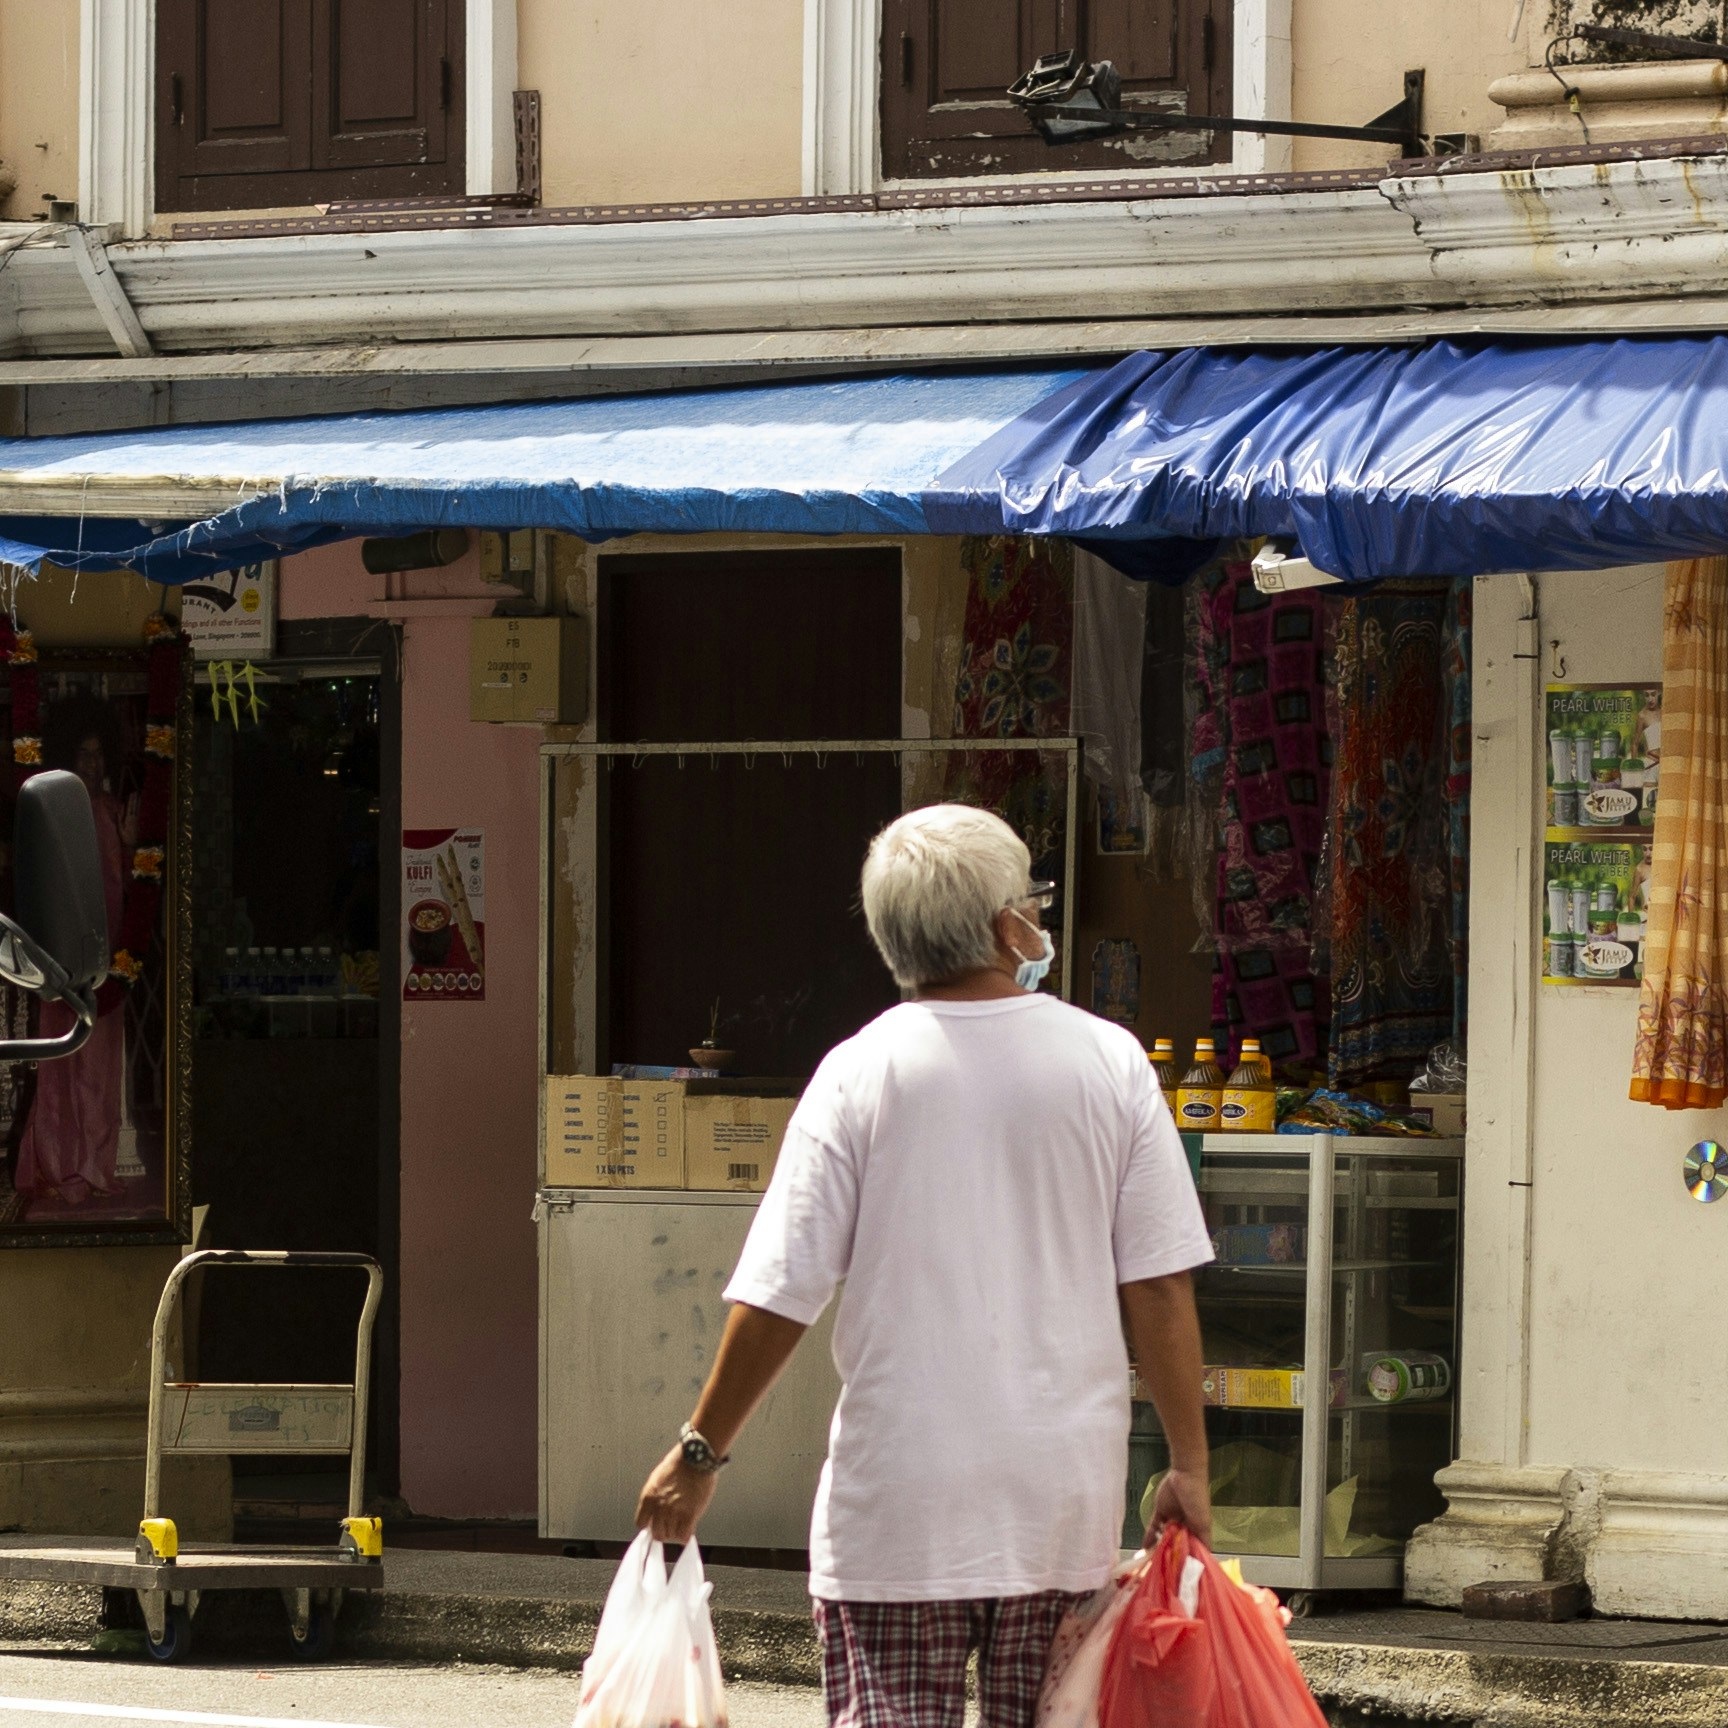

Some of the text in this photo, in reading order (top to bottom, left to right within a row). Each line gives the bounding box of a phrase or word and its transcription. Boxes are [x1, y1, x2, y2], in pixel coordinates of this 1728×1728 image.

[1552, 697, 1633, 713] PEARL WHITE
[1605, 796, 1632, 814] JAMU
[1551, 849, 1630, 865] PEARL WHITE
[406, 866, 433, 881] KULFI
[1601, 948, 1629, 964] JAMU
